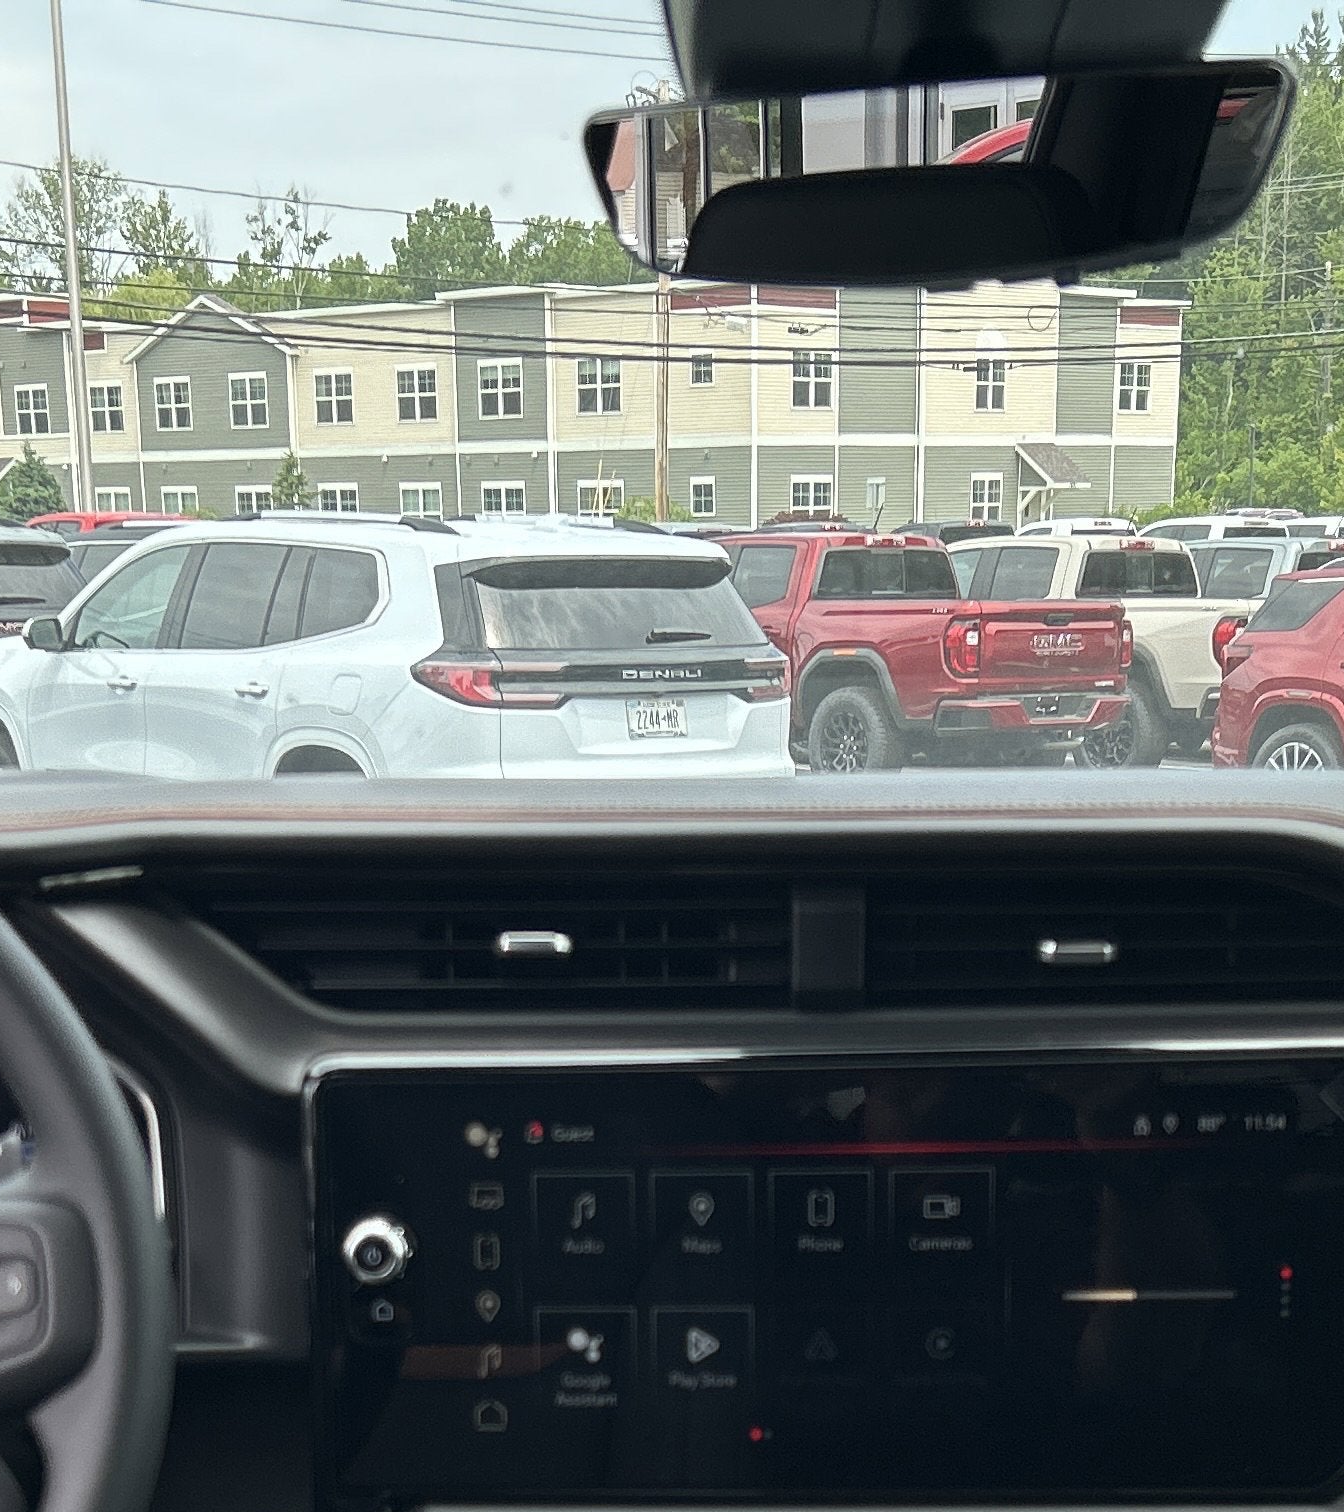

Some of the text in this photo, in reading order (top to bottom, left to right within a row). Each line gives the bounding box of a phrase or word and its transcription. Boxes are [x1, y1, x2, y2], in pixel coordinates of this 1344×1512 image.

[622, 668, 702, 680] DENALI
[562, 1238, 605, 1255] Audio
[797, 1236, 845, 1253] Phone
[560, 1371, 612, 1392] Google
[668, 1371, 700, 1391] Play
